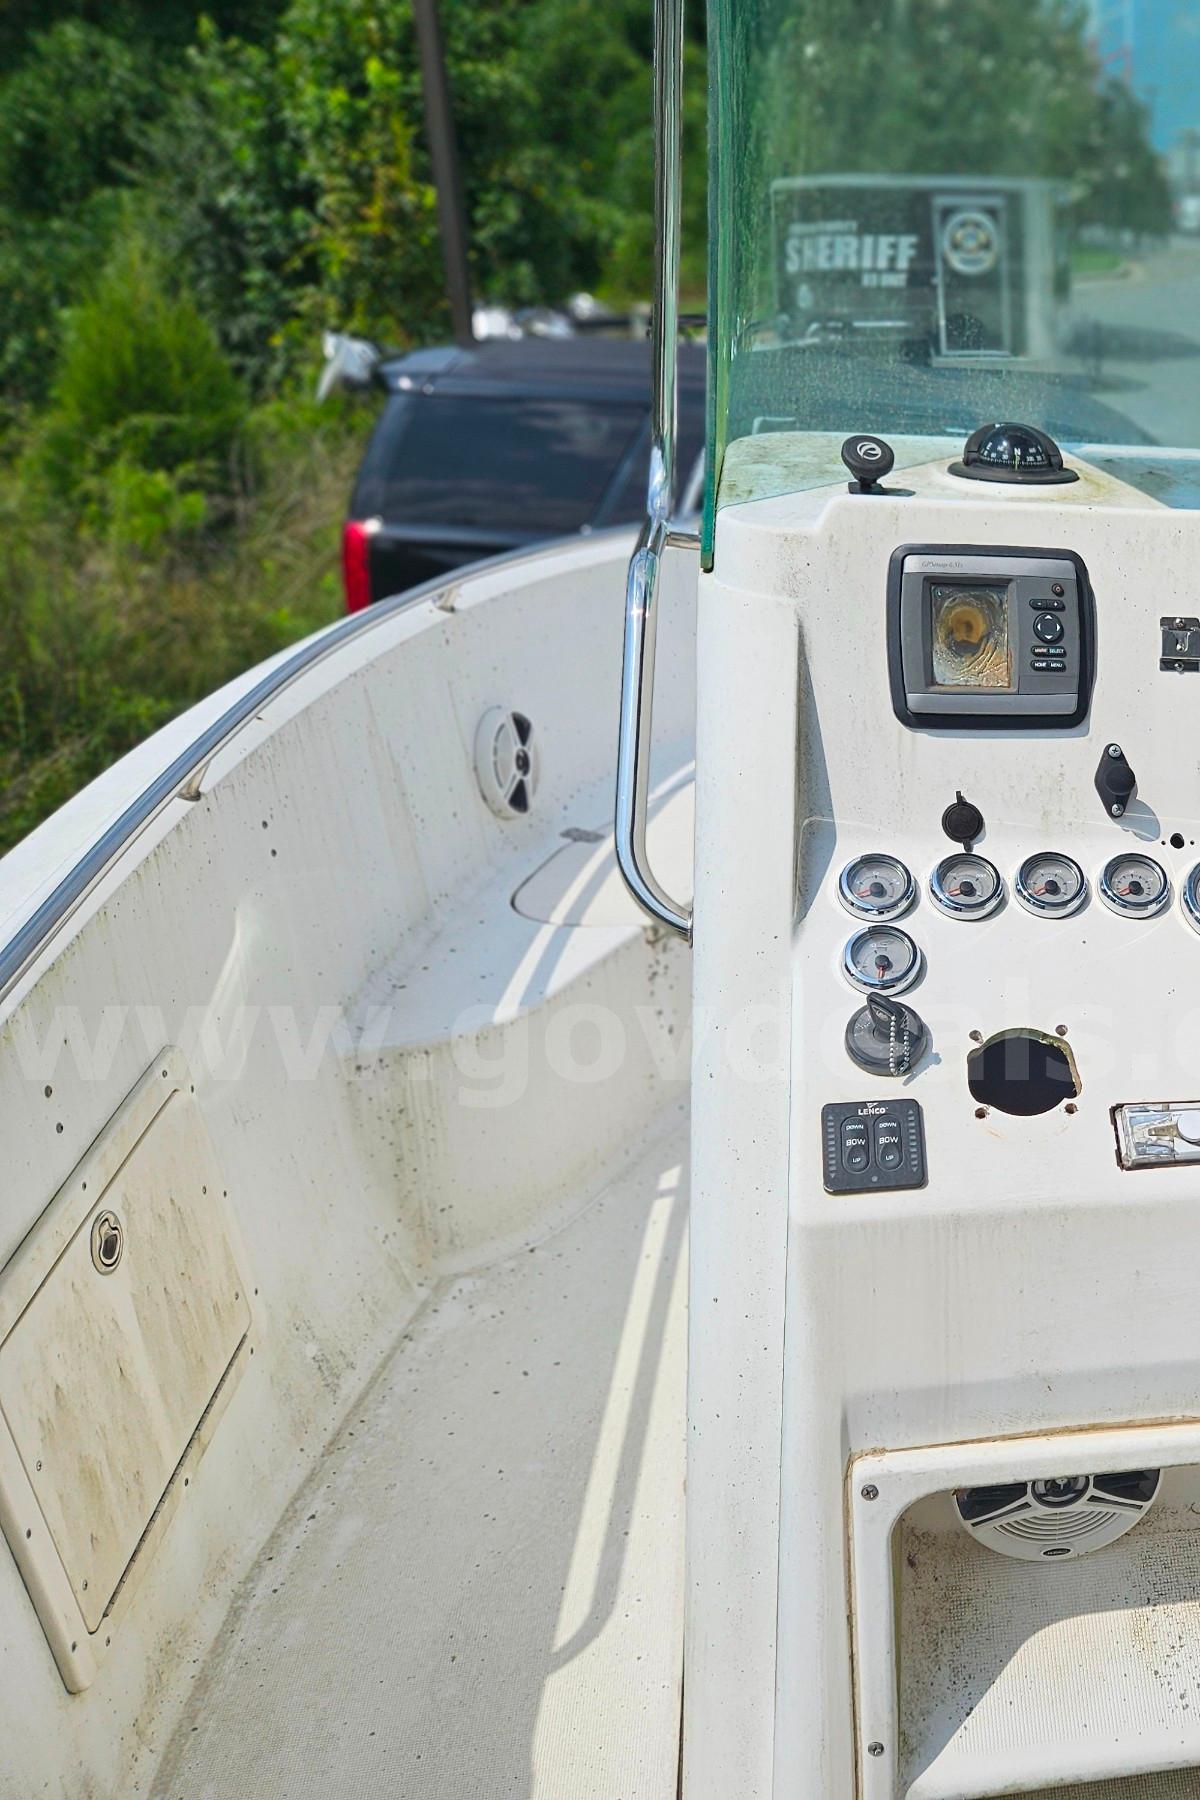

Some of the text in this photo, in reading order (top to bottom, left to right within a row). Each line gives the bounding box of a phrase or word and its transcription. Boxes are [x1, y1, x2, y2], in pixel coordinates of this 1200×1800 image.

[785, 233, 918, 273] SHERIFF
[1014, 447, 1020, 455] N
[858, 1108, 886, 1116] LENCO
